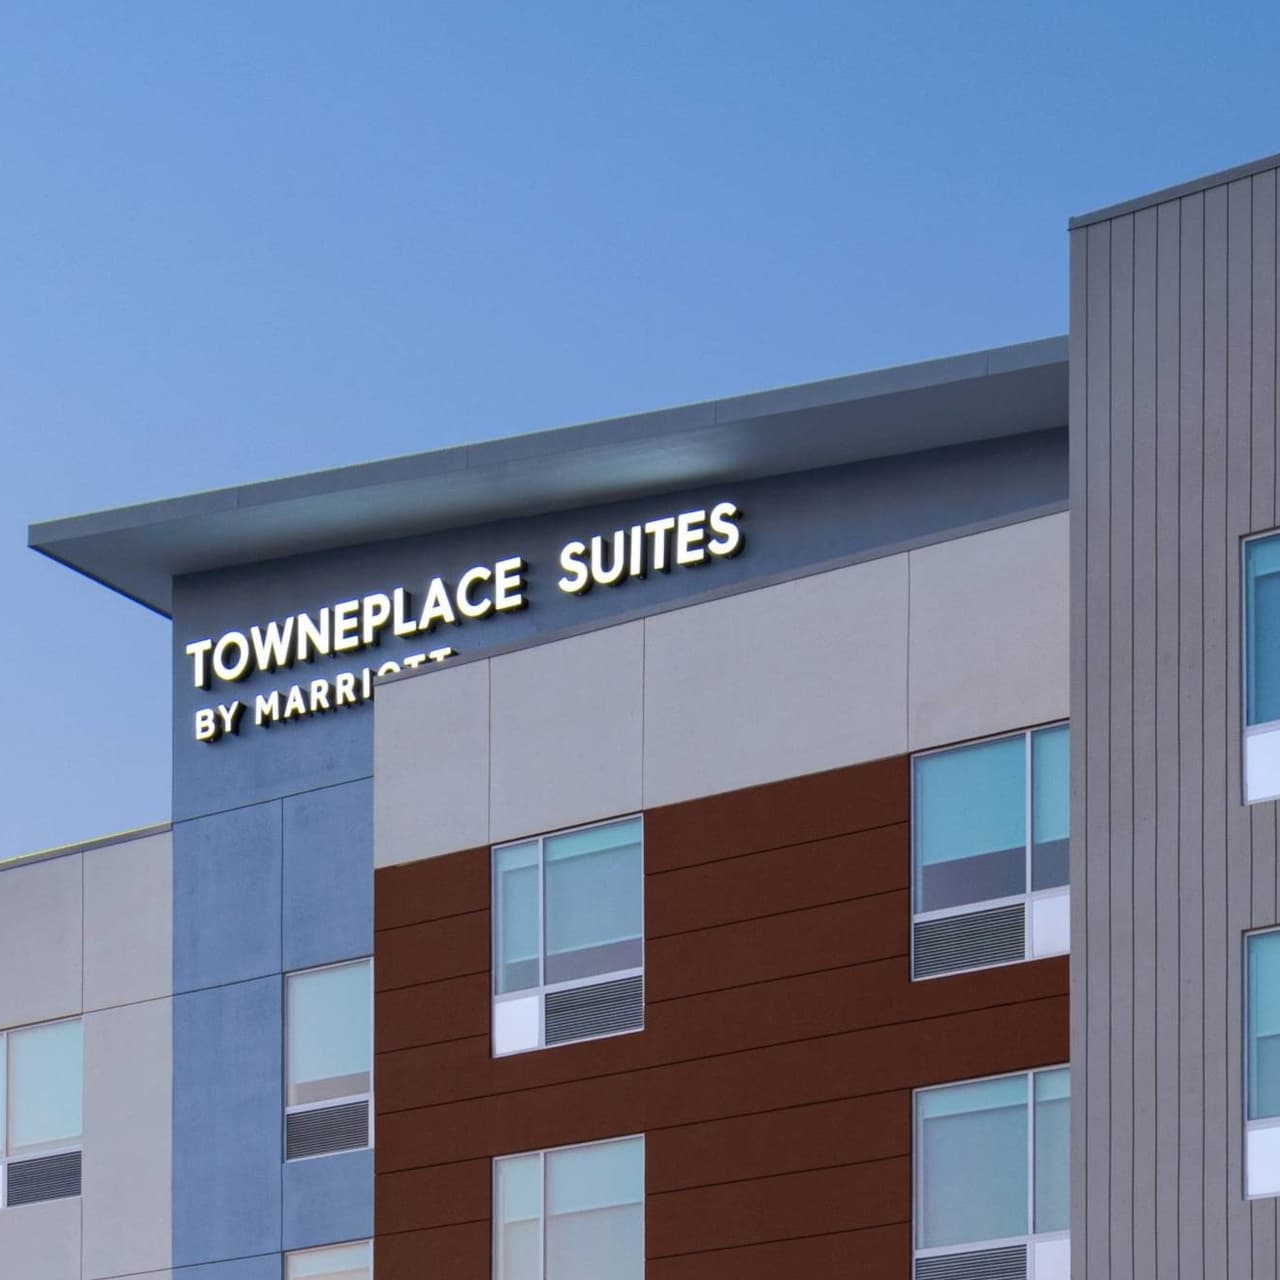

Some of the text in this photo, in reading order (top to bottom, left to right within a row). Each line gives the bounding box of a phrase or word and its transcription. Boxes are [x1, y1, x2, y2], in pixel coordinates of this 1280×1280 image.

[185, 502, 740, 689] TOWNEPLACE SUITES
[195, 700, 240, 741] BY
